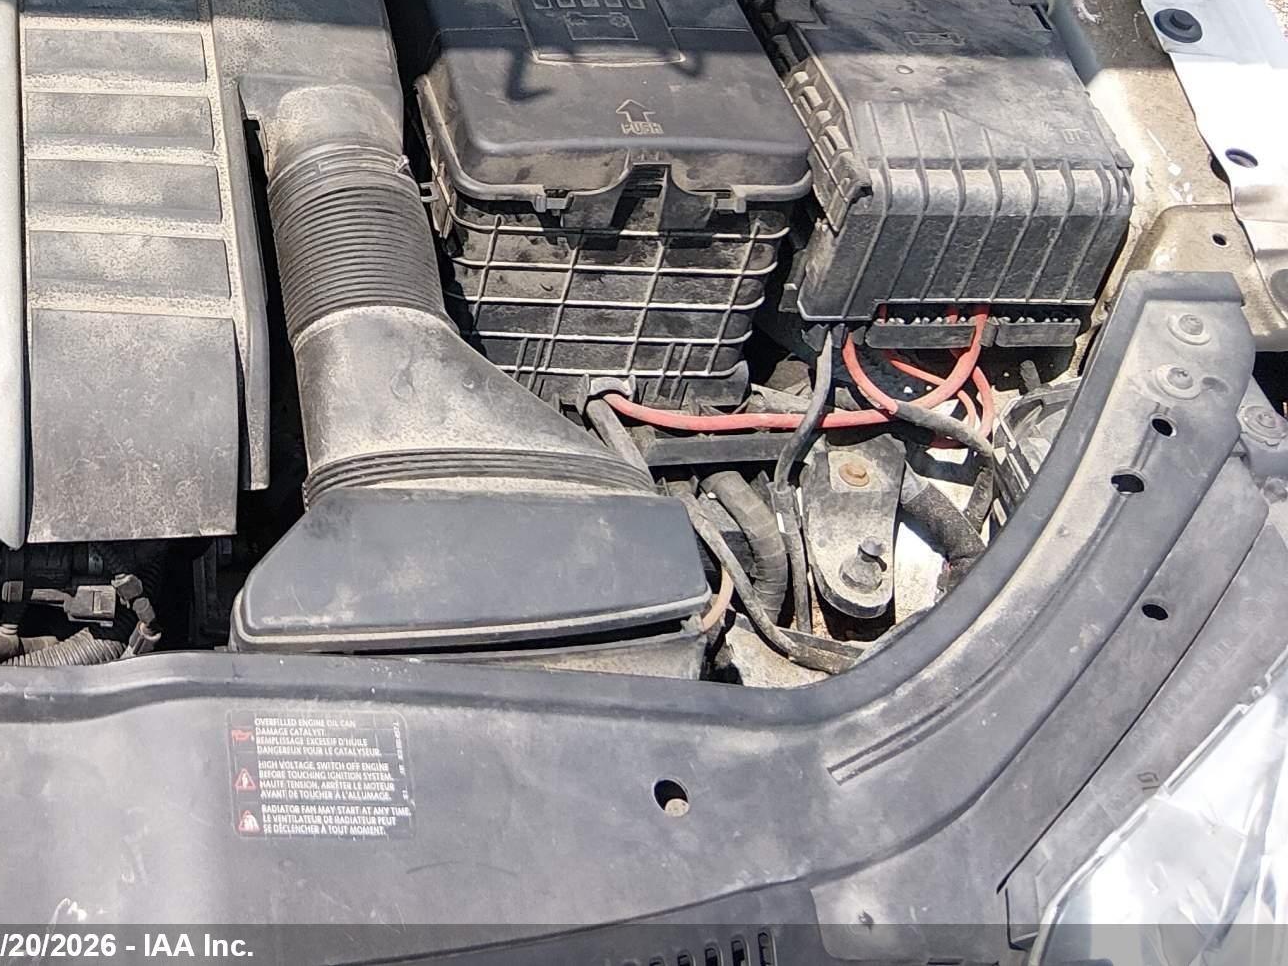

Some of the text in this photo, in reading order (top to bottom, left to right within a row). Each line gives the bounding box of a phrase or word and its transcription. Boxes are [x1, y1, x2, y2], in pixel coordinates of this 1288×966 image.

[256, 727, 288, 736] DAMAGE
[258, 760, 278, 769] HIGH
[316, 761, 344, 770] SWITCH
[346, 762, 360, 771] OFF
[362, 762, 389, 771] ENGINE
[288, 771, 326, 780] TOUCHING
[260, 780, 283, 789] HAUTE
[260, 790, 287, 799] AVANT
[262, 804, 299, 814] RADIATOR
[301, 805, 316, 814] FAN
[318, 805, 335, 815] MAY
[337, 806, 359, 815] START
[362, 806, 370, 815] AT
[374, 806, 389, 816] ANY
[378, 816, 396, 825] PEUT
[328, 826, 349, 834] TOUT
